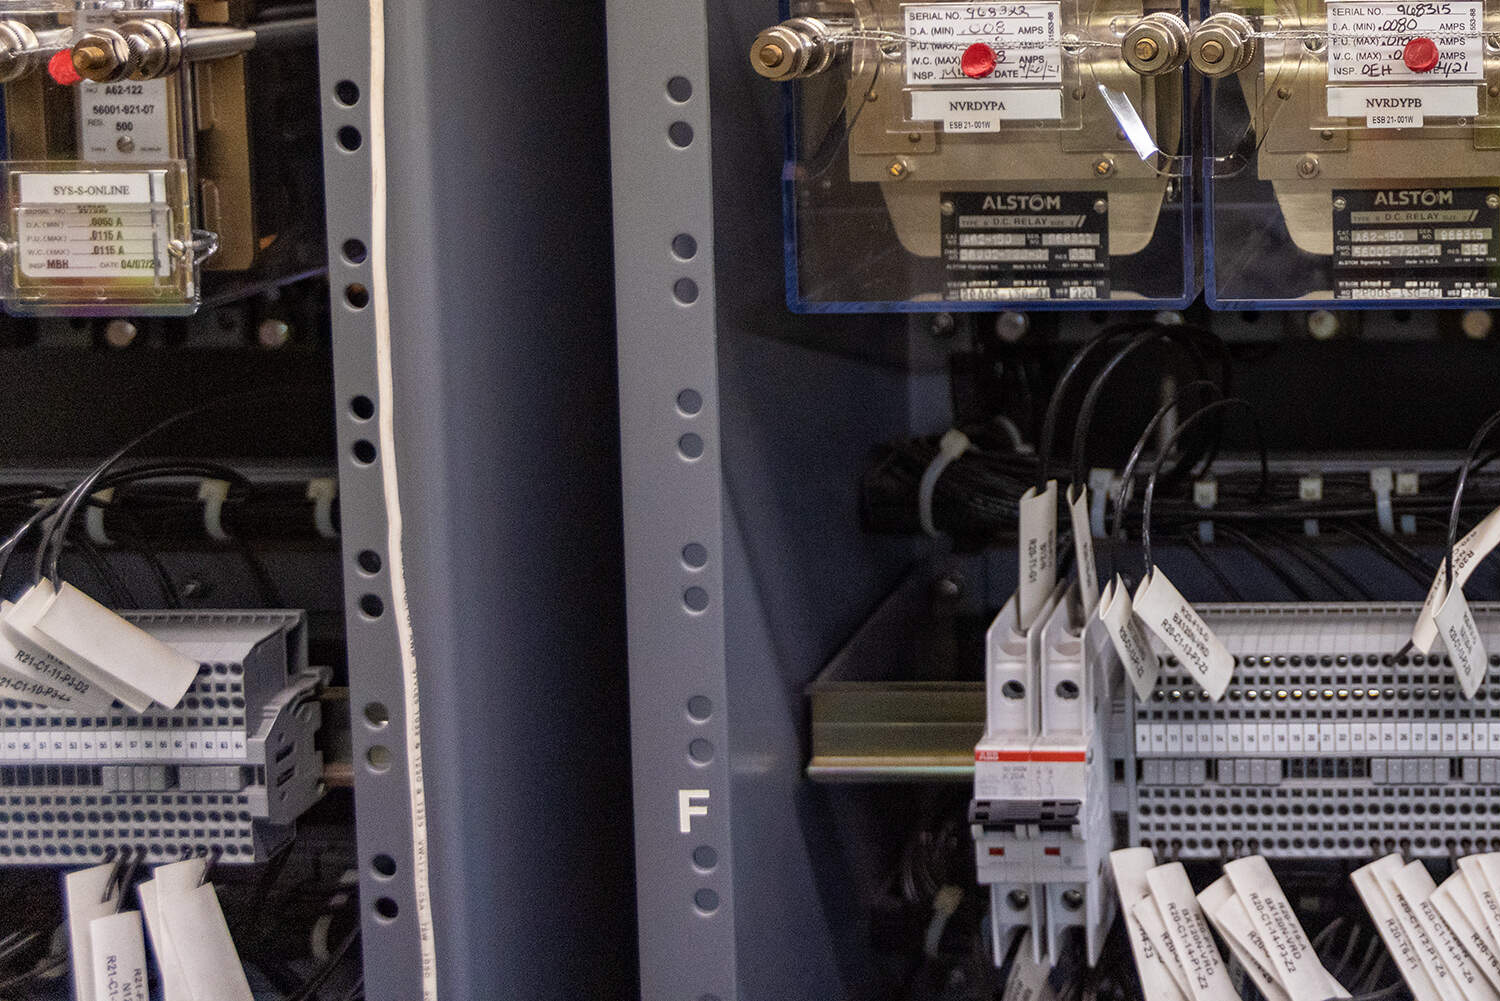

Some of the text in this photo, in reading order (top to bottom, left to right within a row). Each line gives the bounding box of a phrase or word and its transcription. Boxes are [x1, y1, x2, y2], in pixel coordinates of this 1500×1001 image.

[1332, 3, 1452, 18] SERIAL NO. 968315
[909, 12, 943, 21] SERIAL
[930, 27, 955, 36] (MIN)
[1017, 26, 1044, 35] AMPS
[1352, 22, 1376, 32] (MIN)
[1439, 23, 1466, 31] AMPS
[1439, 37, 1466, 46] AMPS
[934, 56, 961, 65] (MAX)
[1019, 55, 1045, 64] AMPS
[1356, 52, 1382, 61] (MAX)
[1440, 51, 1466, 60] AMPS
[994, 69, 1019, 78] DATE
[105, 85, 144, 95] A62-122
[949, 101, 1006, 111] NVRDYPA
[1366, 98, 1422, 108] NVRDYPB
[949, 121, 991, 129] ESB 21-001W
[1372, 116, 1414, 124] ESB 21-001W
[53, 185, 131, 196] SYS-S-ONLINE
[982, 194, 1061, 211] ALSTOM
[1374, 190, 1453, 206] ALSTOM
[1013, 217, 1049, 226] RELAY
[1406, 212, 1440, 221] RELAY
[679, 789, 710, 833] F
